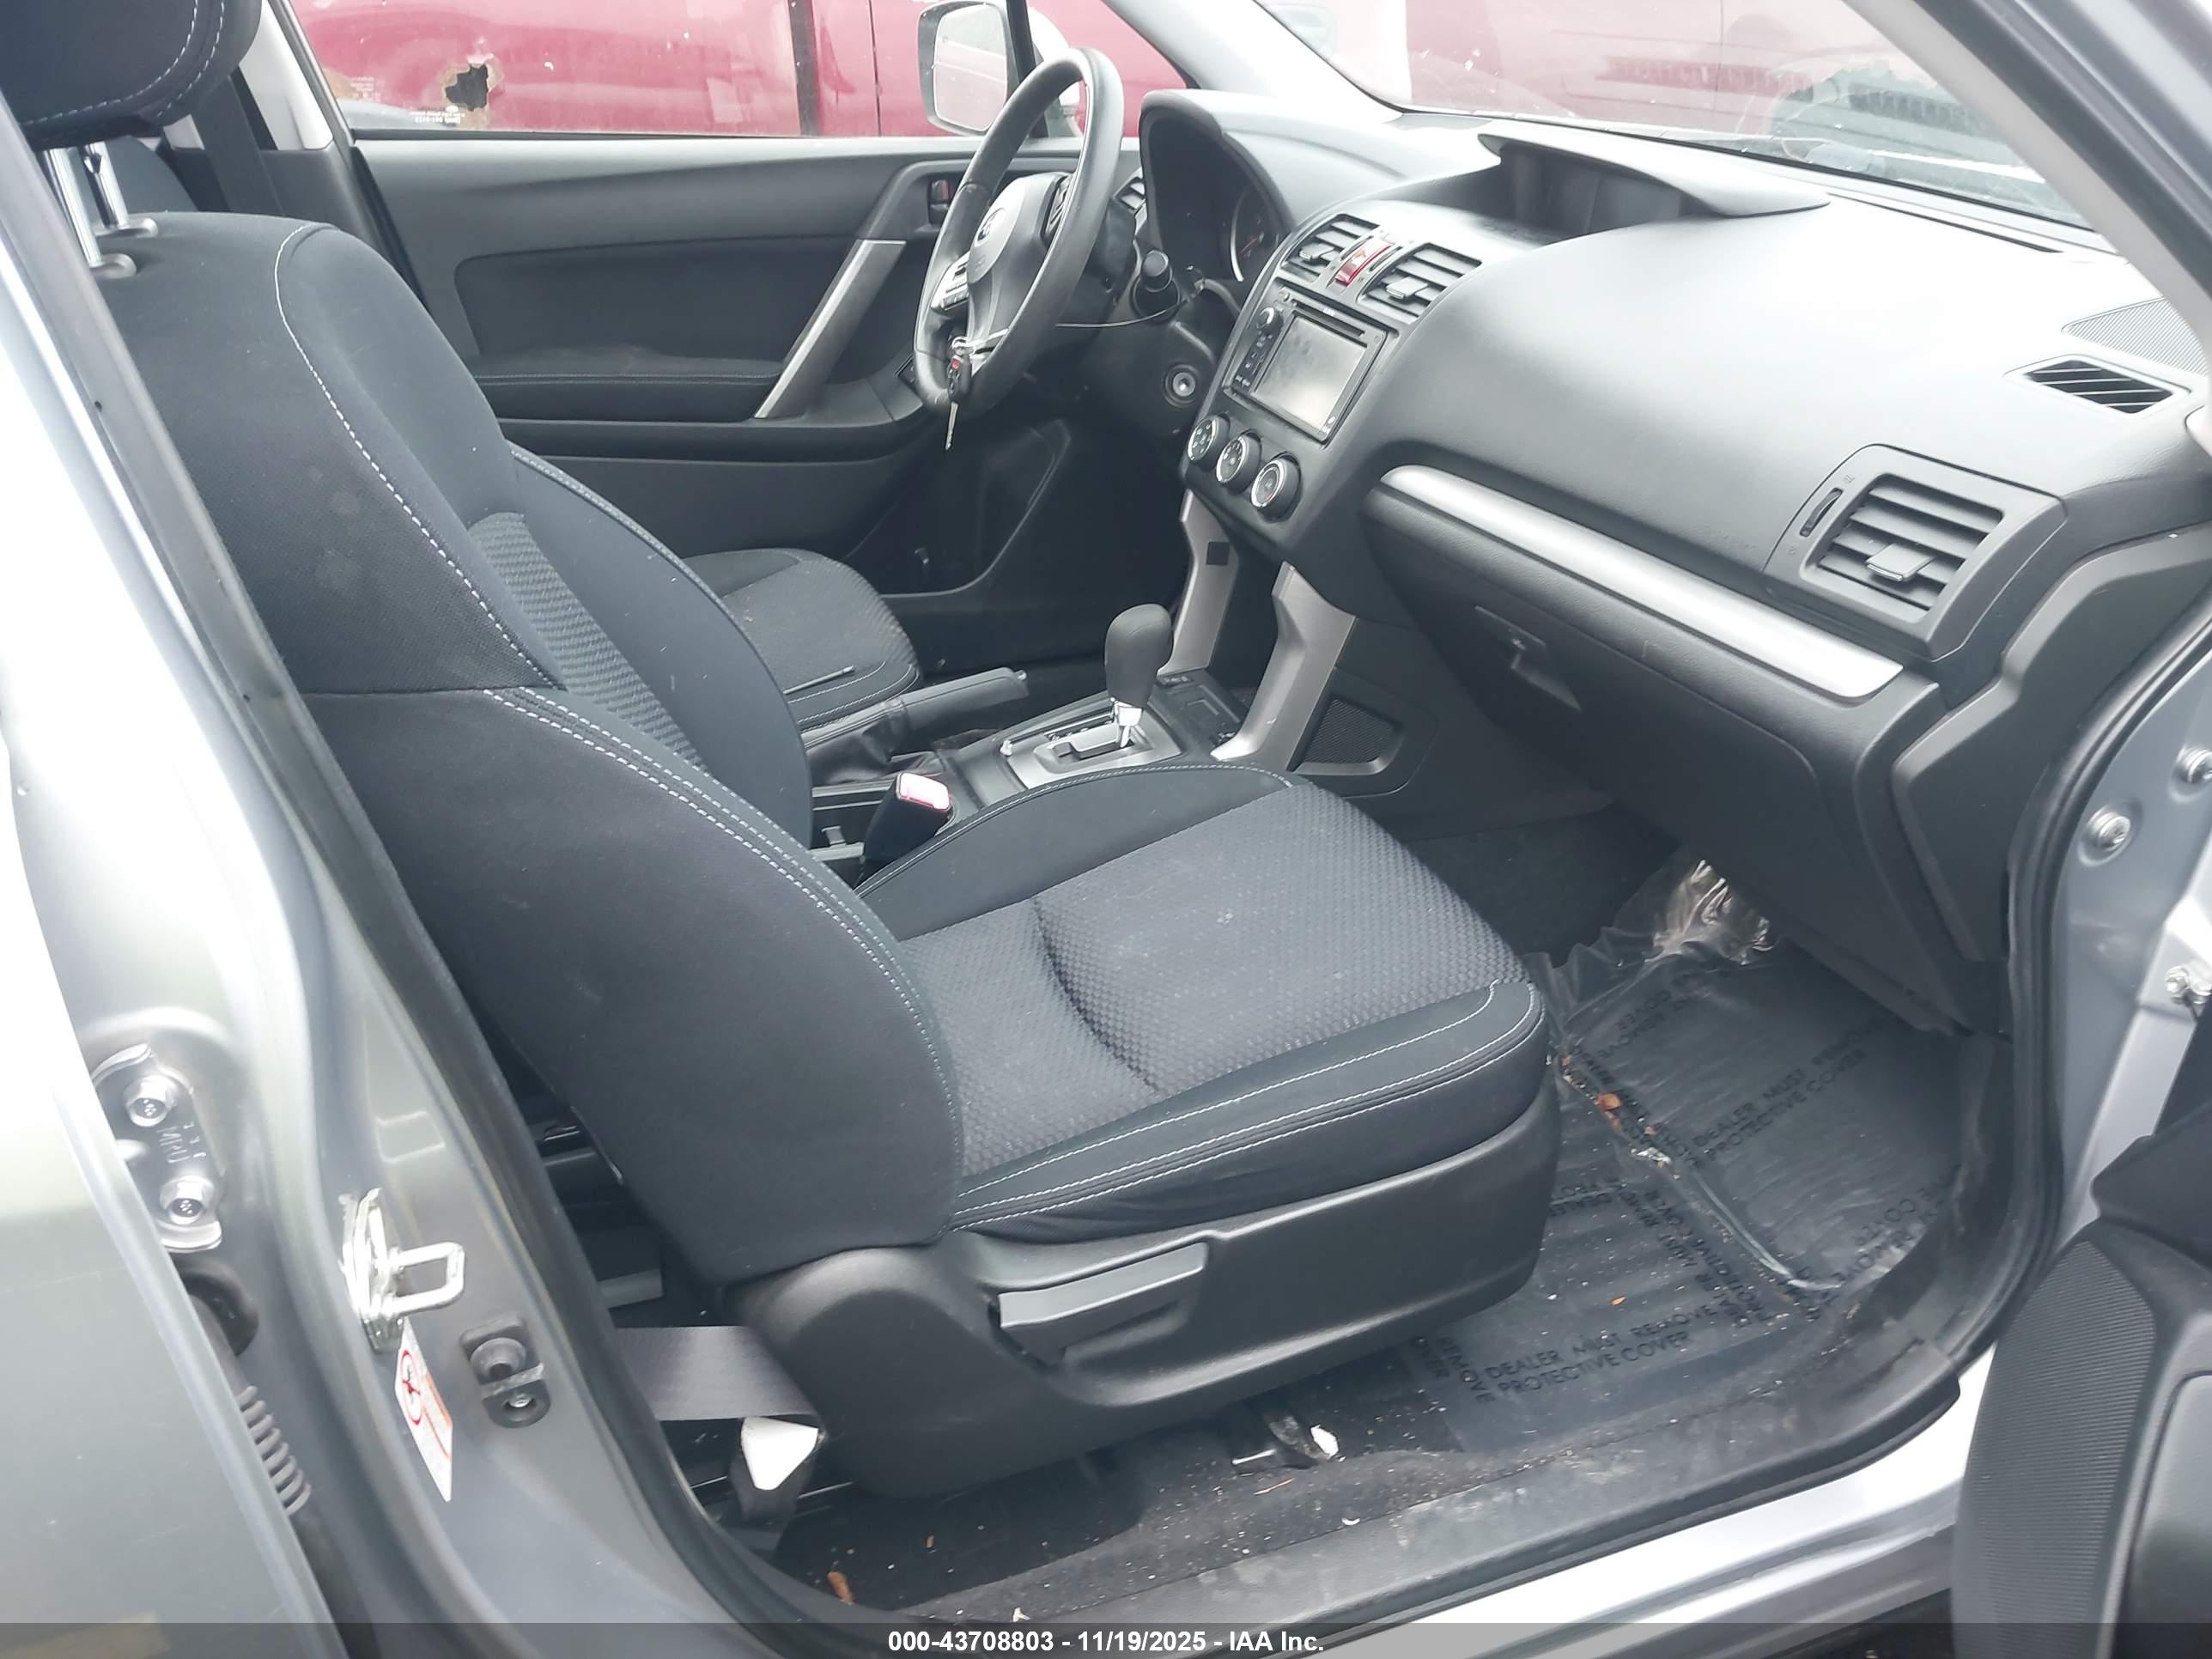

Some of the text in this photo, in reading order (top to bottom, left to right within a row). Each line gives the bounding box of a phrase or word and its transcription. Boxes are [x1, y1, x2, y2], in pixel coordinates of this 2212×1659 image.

[1692, 1102, 1756, 1147] DEALER
[1704, 1091, 1807, 1162] PROTECTIVE
[1806, 1048, 1867, 1092] COVER
[1485, 1304, 1718, 1380] DEALER MUST REMOVE
[1498, 1330, 1689, 1392] PROTECTIVE COVER
